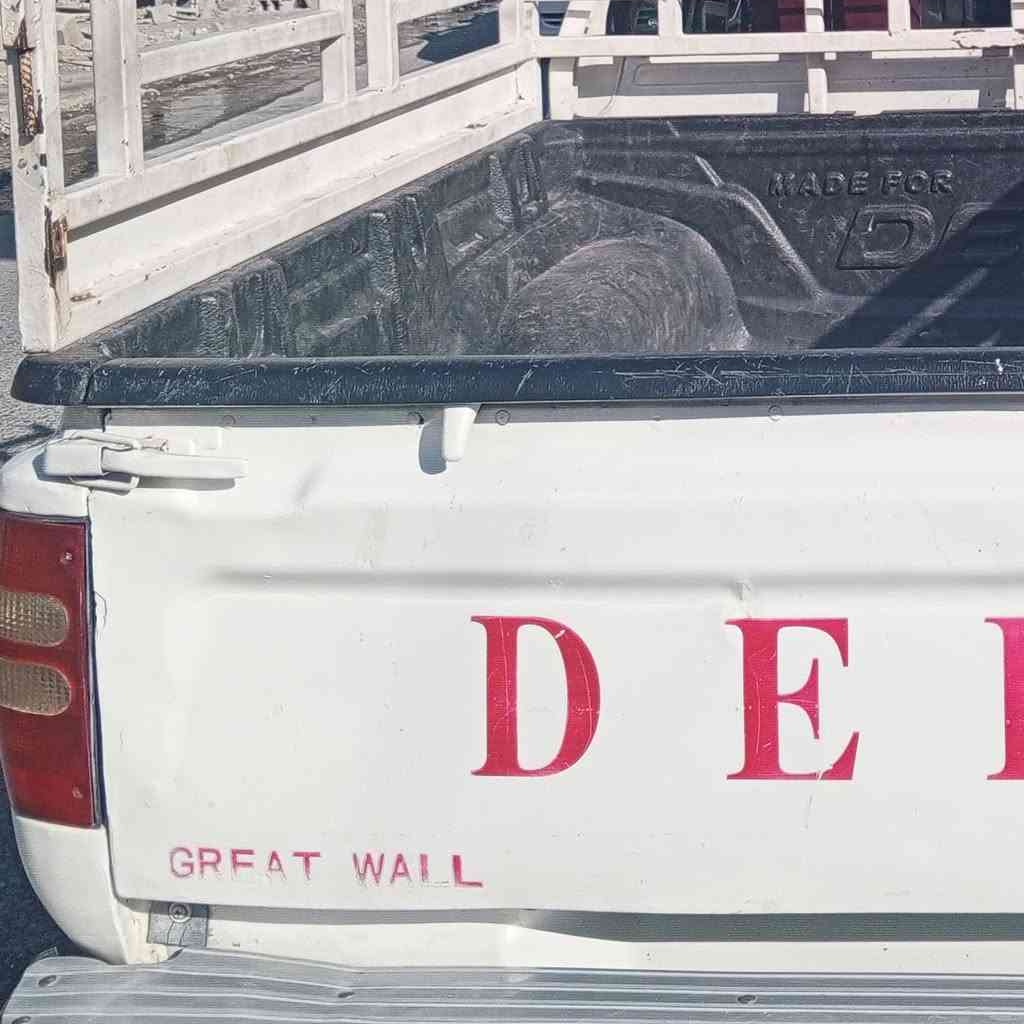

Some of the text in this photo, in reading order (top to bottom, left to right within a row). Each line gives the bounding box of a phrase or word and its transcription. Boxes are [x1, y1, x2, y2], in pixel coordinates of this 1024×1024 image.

[767, 168, 955, 198] MADE FOR
[168, 846, 484, 889] GREAT WALL
